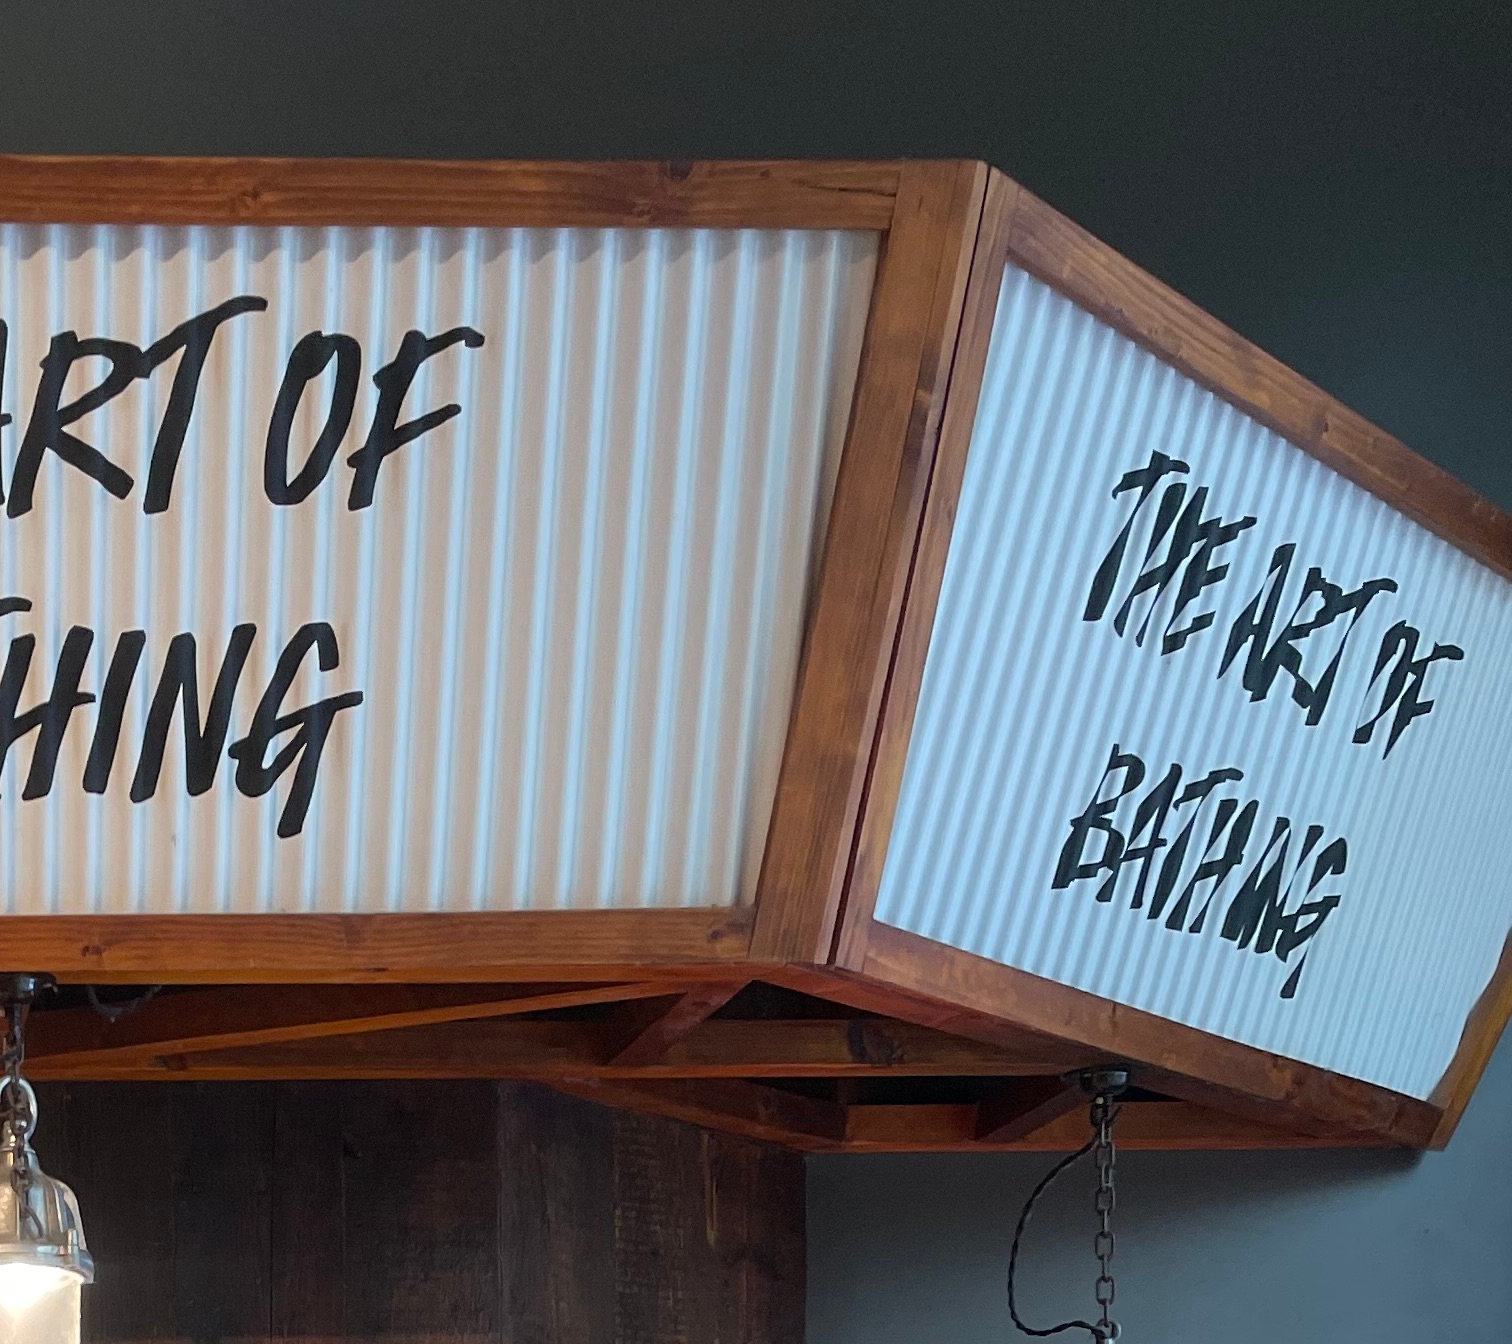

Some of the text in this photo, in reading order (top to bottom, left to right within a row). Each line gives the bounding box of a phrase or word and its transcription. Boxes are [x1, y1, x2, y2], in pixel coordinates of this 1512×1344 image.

[263, 328, 486, 512] OF
[1083, 450, 1465, 760] THE ART OF
[1051, 743, 1348, 999] BATHING
